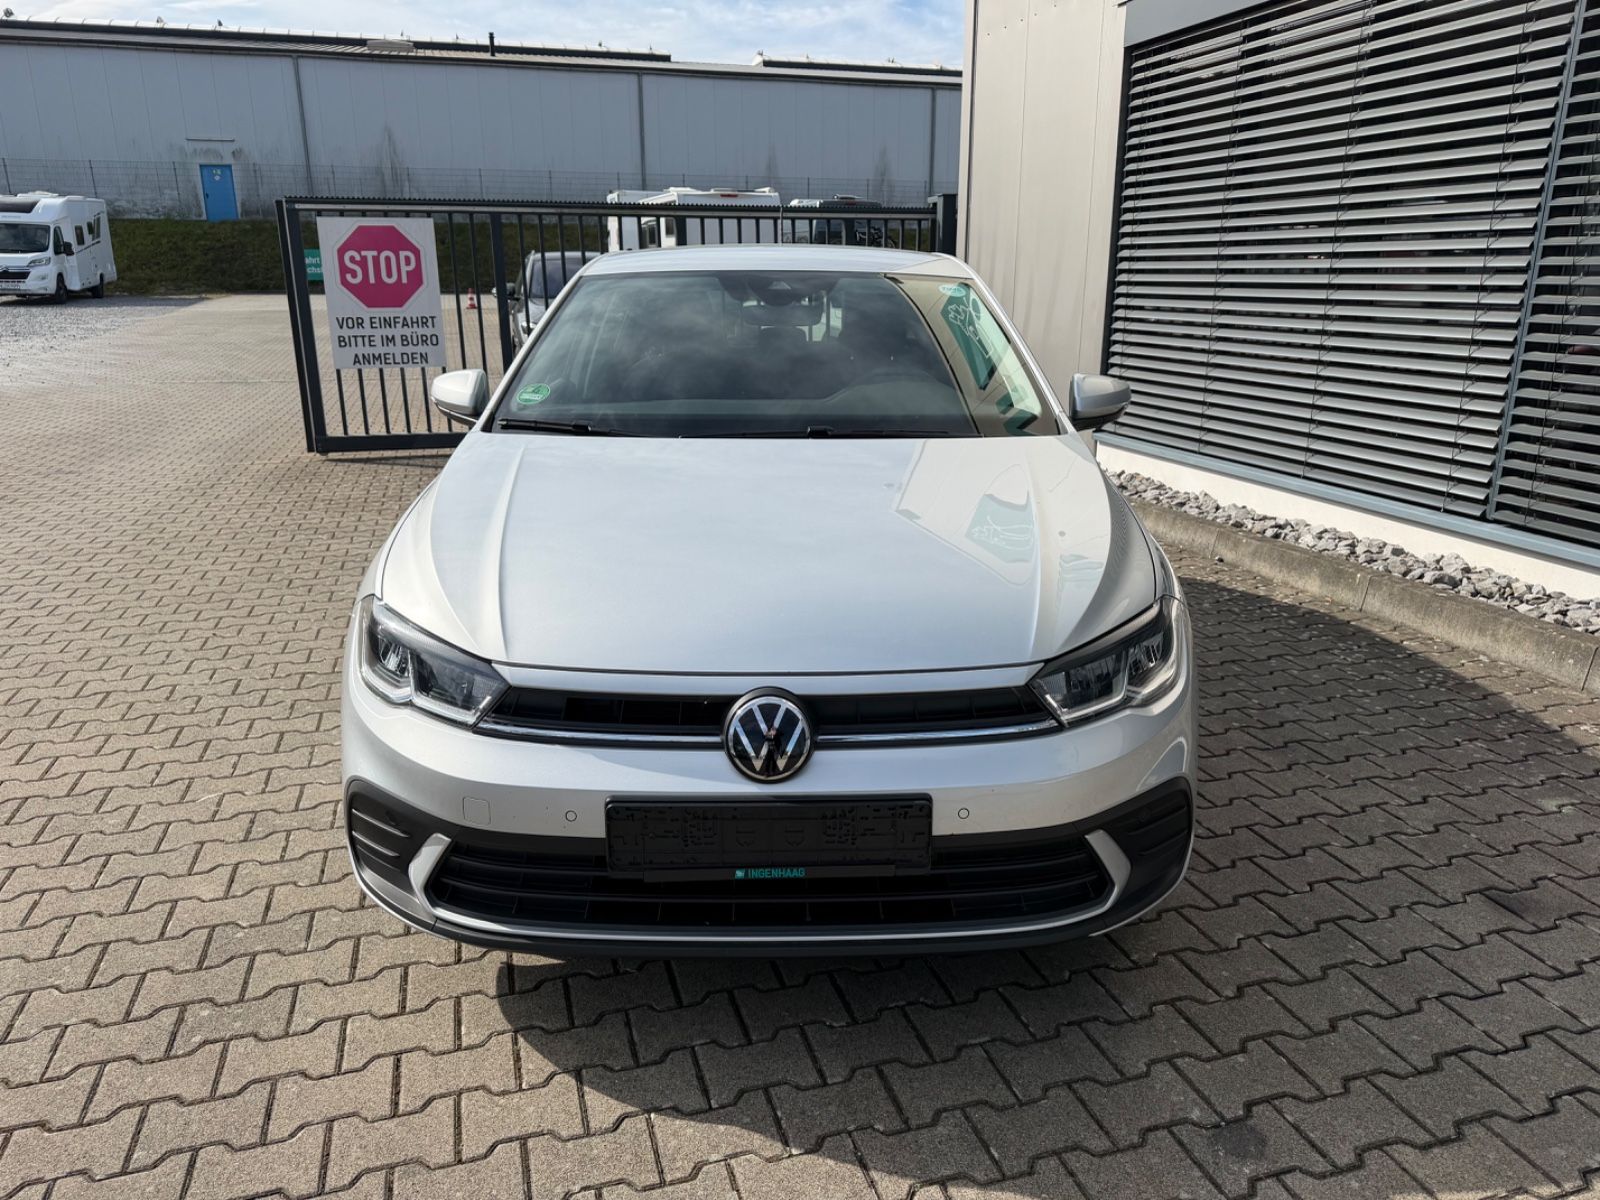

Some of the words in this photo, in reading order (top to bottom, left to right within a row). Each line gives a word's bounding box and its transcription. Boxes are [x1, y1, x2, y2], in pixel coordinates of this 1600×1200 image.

[343, 250, 416, 285] STOP
[336, 316, 365, 329] VOR
[369, 316, 437, 329] EINFAHRT
[337, 335, 376, 348] BITTE
[381, 334, 396, 347] IM
[400, 331, 439, 347] BÜRO
[353, 352, 429, 365] ANMELDEN
[748, 867, 805, 878] INGENHAAG
